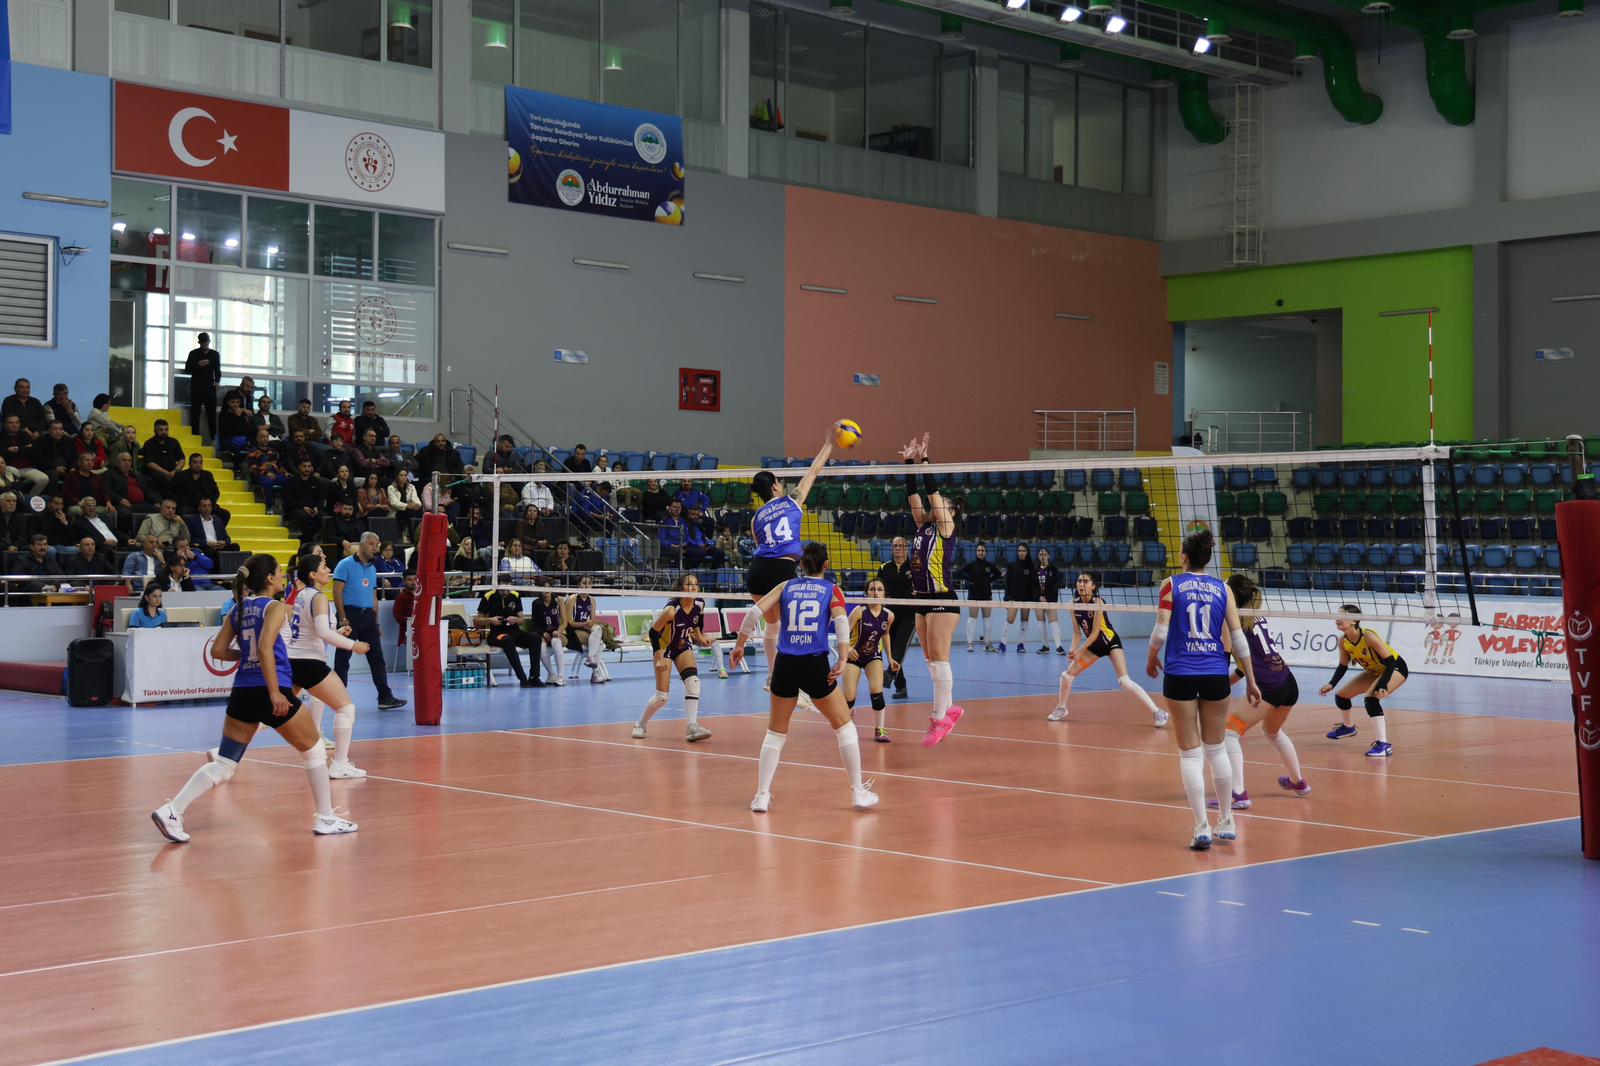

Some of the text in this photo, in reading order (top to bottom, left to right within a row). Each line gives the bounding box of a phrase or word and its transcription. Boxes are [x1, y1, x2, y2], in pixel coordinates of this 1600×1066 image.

[587, 178, 650, 200] Abdurrahman
[588, 191, 617, 208] Yıldız
[763, 516, 793, 545] 14
[546, 617, 552, 625] 8
[787, 599, 821, 632] 12
[1186, 602, 1214, 640] 11
[243, 628, 260, 661] 7
[790, 633, 812, 647] OPÇİN
[869, 631, 878, 641] 2
[1290, 630, 1339, 653] SİGO
[1478, 634, 1566, 655] VOLEYBO
[1474, 657, 1570, 671] Türkiye Voleybol Federasy
[144, 689, 168, 697] Türkiye
[169, 688, 198, 696] Voleybol
